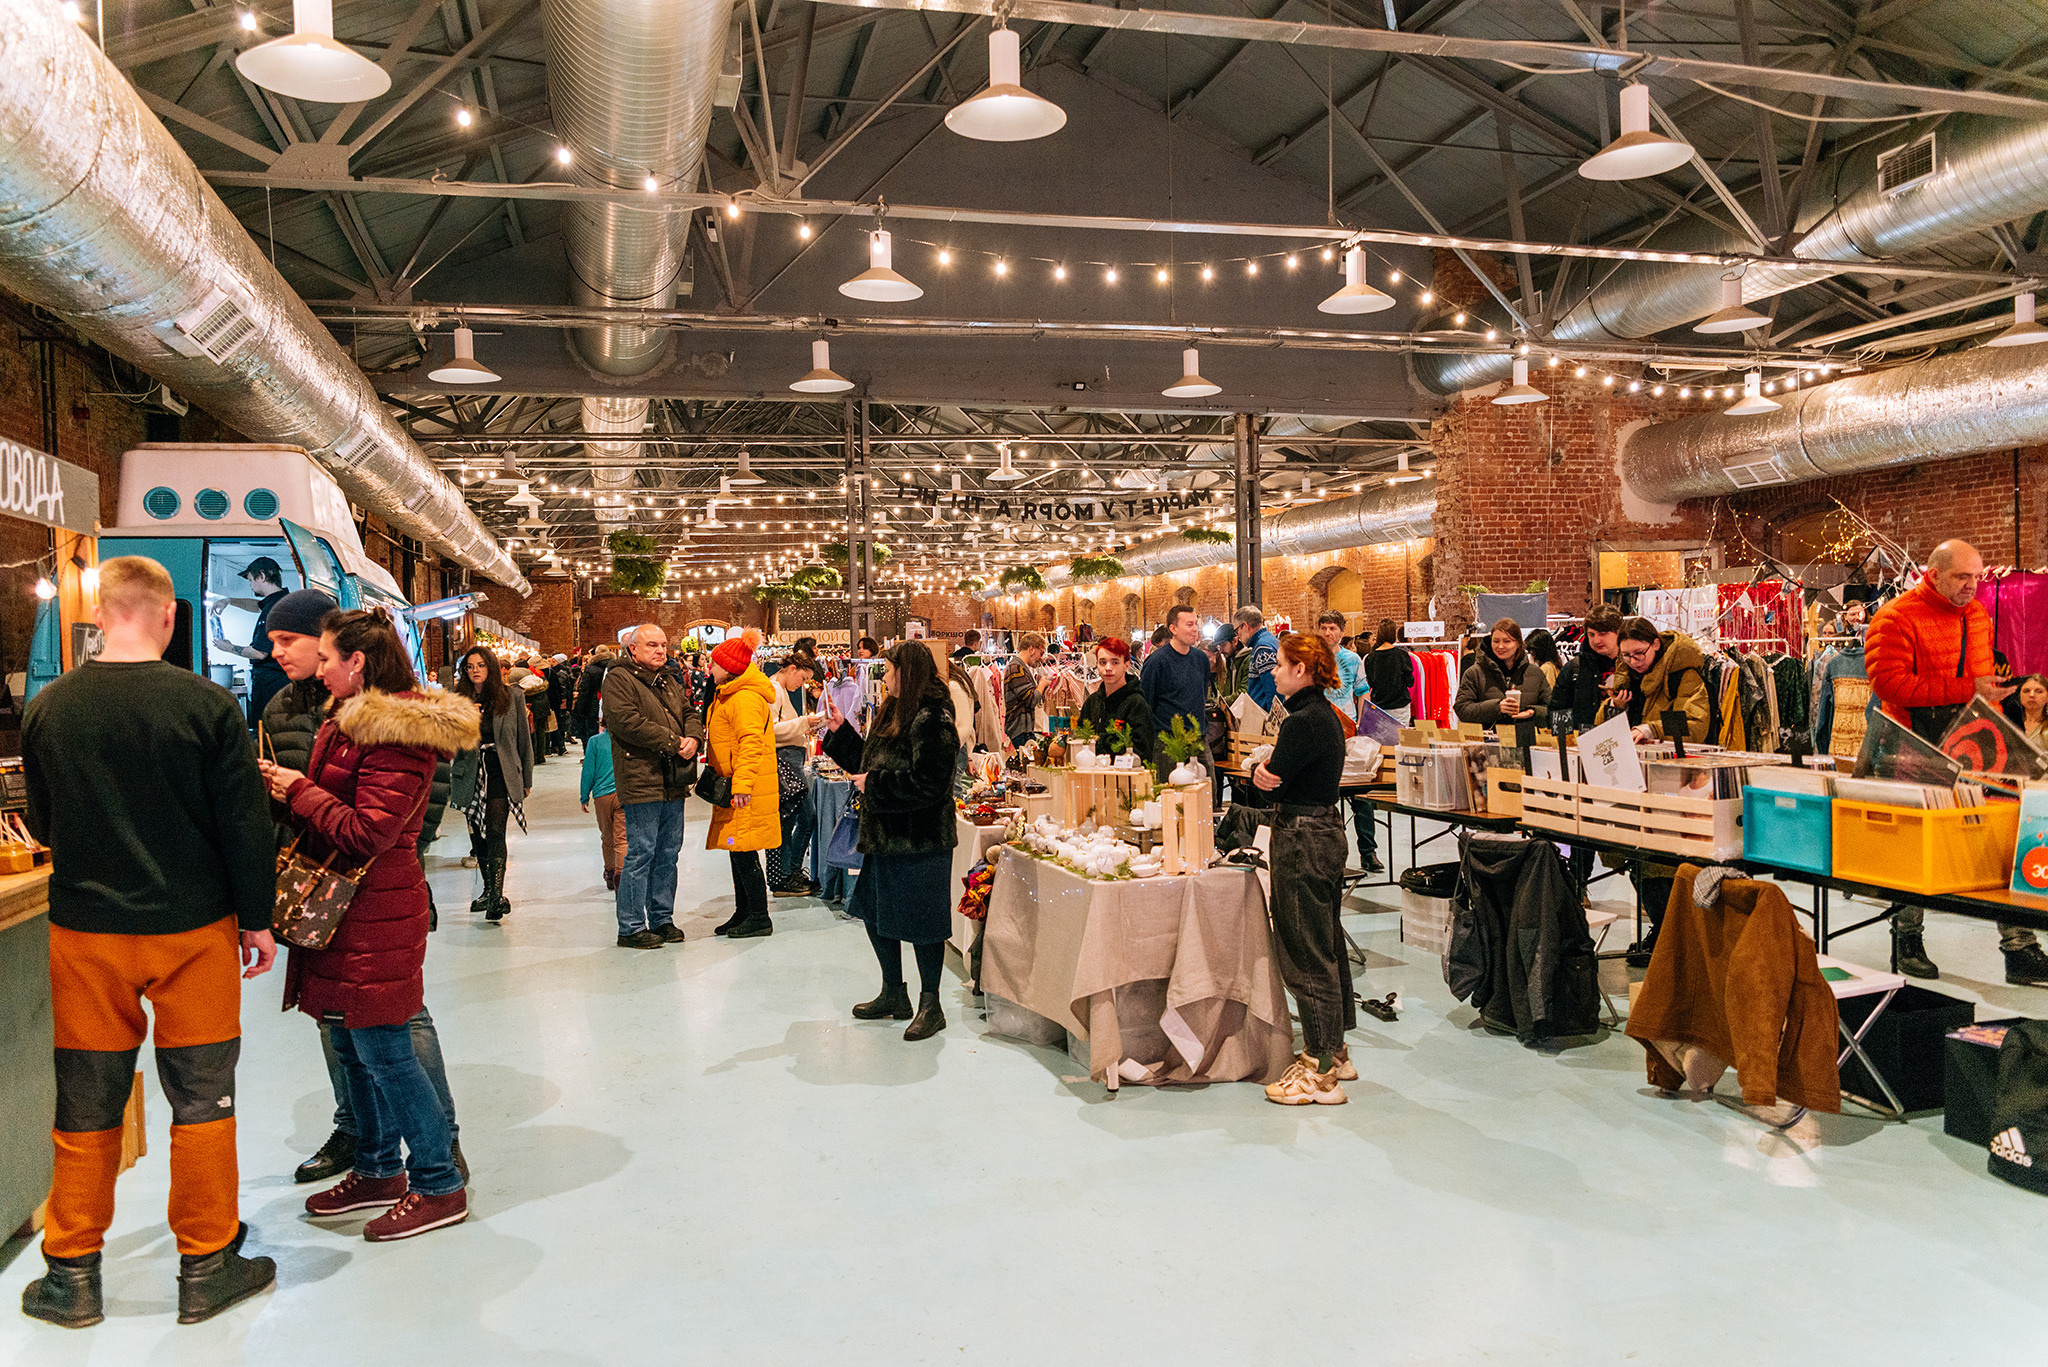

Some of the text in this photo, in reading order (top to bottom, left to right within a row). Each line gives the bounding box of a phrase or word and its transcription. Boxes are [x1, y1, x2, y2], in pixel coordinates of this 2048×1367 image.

[779, 629, 838, 644] СЕДМОЙ
[931, 630, 966, 638] ВОРКШО
[1593, 741, 1619, 758] MONKEYS
[1595, 737, 1613, 751] ARCTIC
[1601, 751, 1613, 759] THE
[1603, 756, 1615, 766] CAR
[1990, 1141, 2033, 1168] adidas
